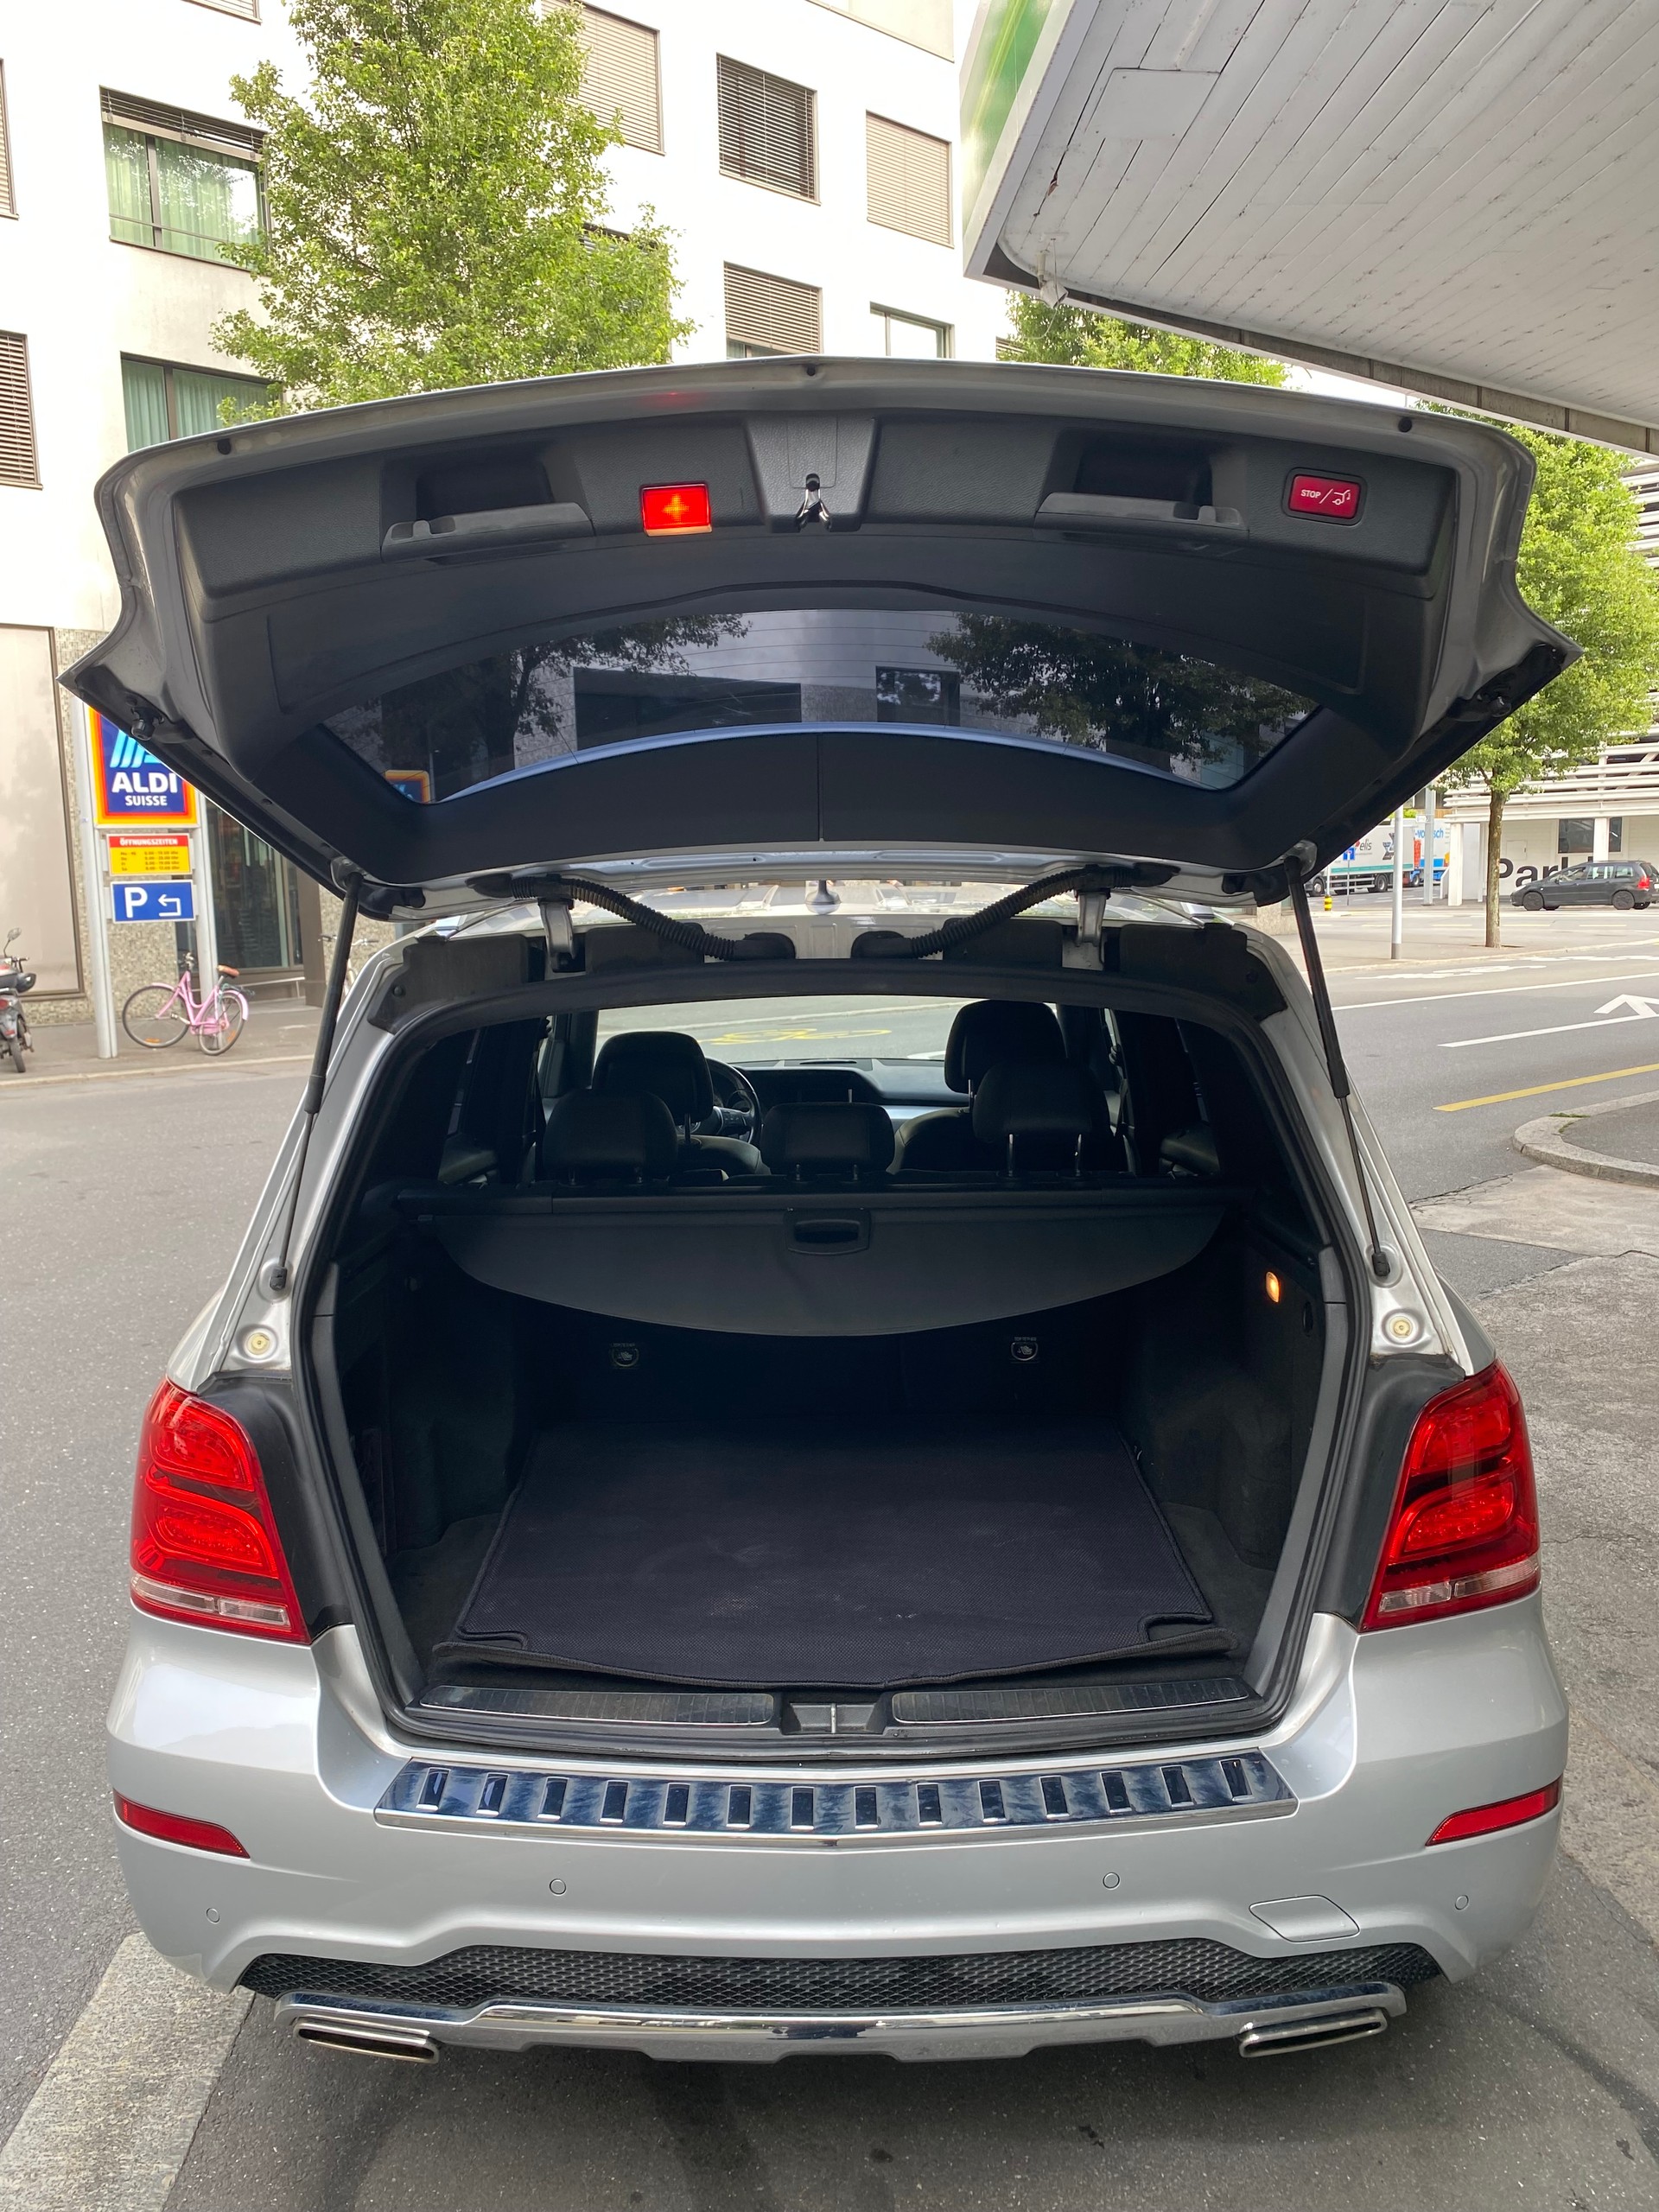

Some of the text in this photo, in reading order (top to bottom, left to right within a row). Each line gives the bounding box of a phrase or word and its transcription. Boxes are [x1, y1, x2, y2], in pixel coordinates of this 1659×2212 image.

[1300, 489, 1321, 499] STOP
[111, 772, 178, 793] ALDI
[124, 795, 168, 806] SUISSE
[1359, 839, 1372, 851] elis
[124, 887, 148, 918] P
